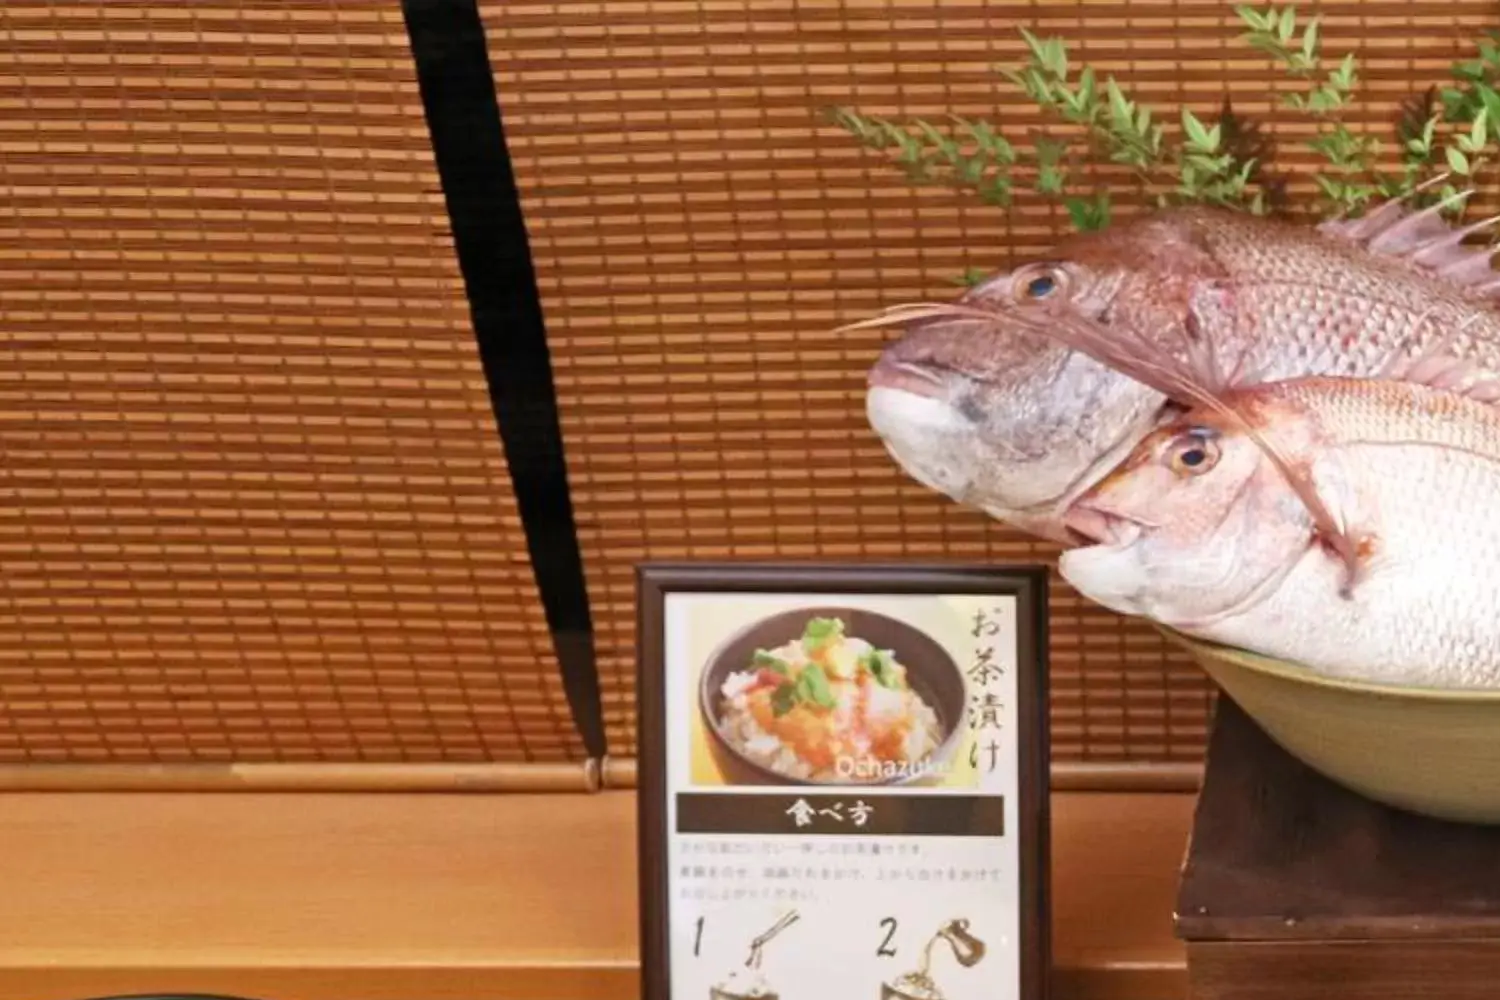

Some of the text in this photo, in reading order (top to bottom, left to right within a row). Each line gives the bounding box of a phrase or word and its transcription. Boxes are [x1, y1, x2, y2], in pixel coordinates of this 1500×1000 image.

[967, 606, 1006, 773] お茶漬け
[785, 798, 875, 828] 食べ方
[692, 915, 706, 958] 1
[875, 916, 899, 959] 2
